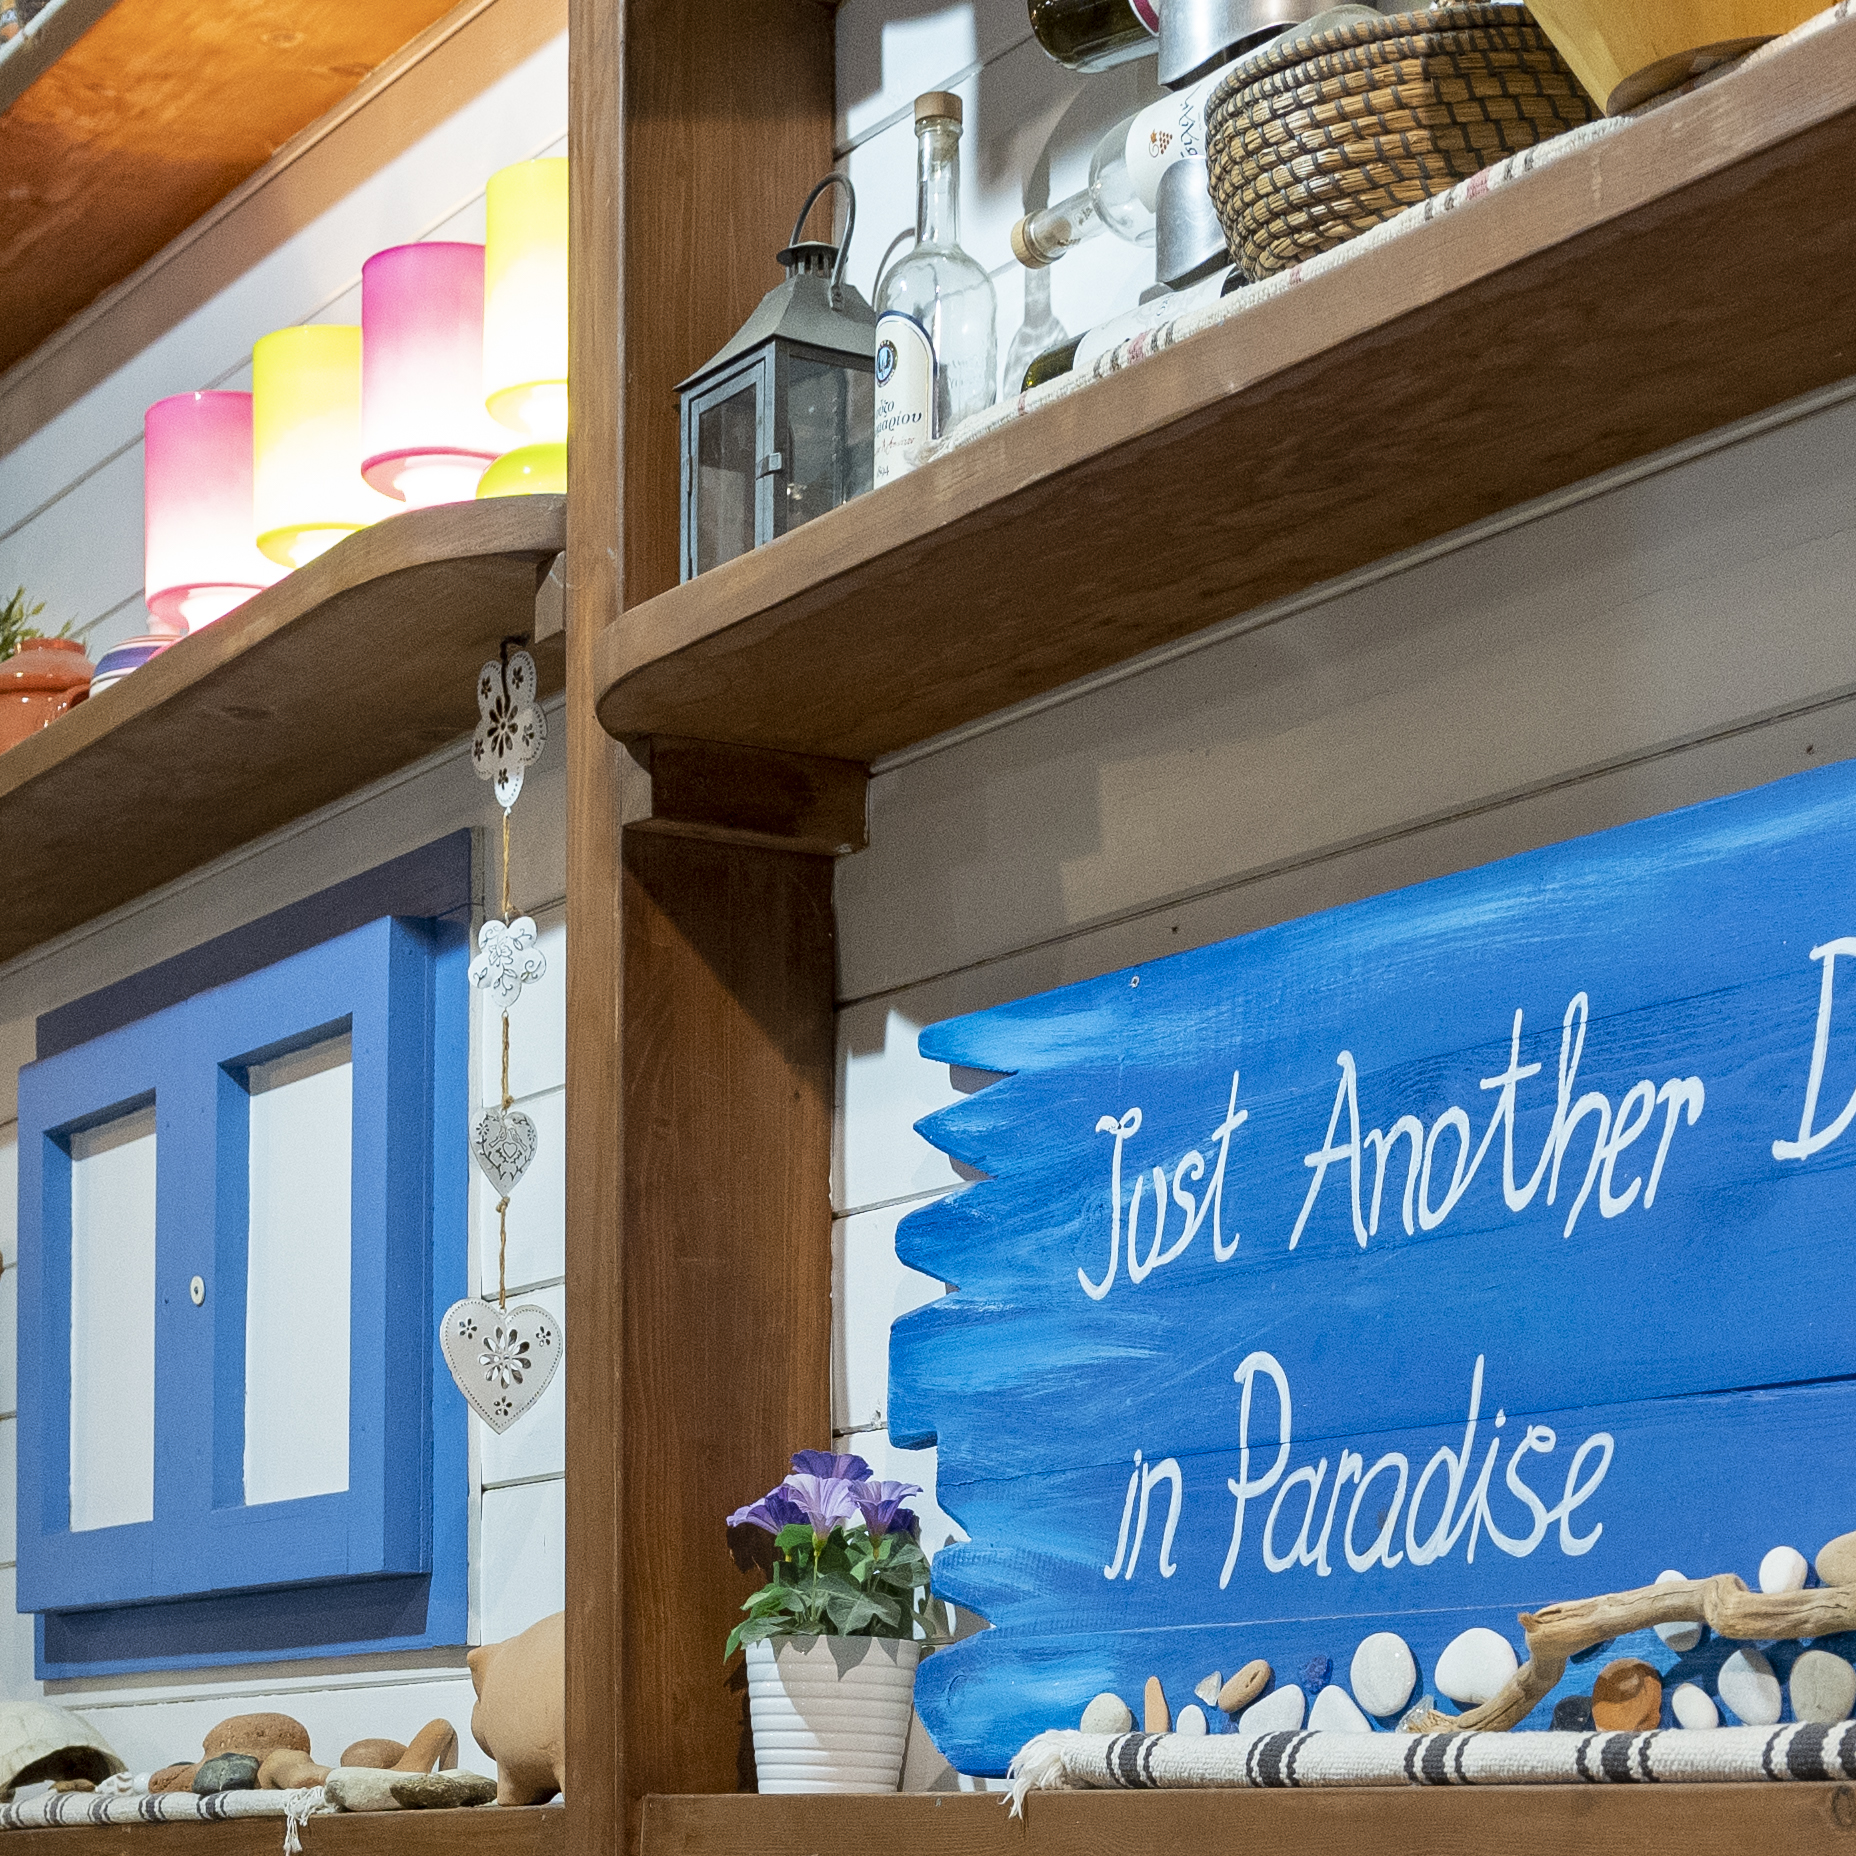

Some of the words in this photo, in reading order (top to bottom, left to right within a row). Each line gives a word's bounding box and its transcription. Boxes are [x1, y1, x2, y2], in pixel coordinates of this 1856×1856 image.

[1078, 1071, 1247, 1300] Just
[1288, 992, 1705, 1248] Another
[1104, 1449, 1183, 1581] in
[1219, 1352, 1616, 1590] Paradise
